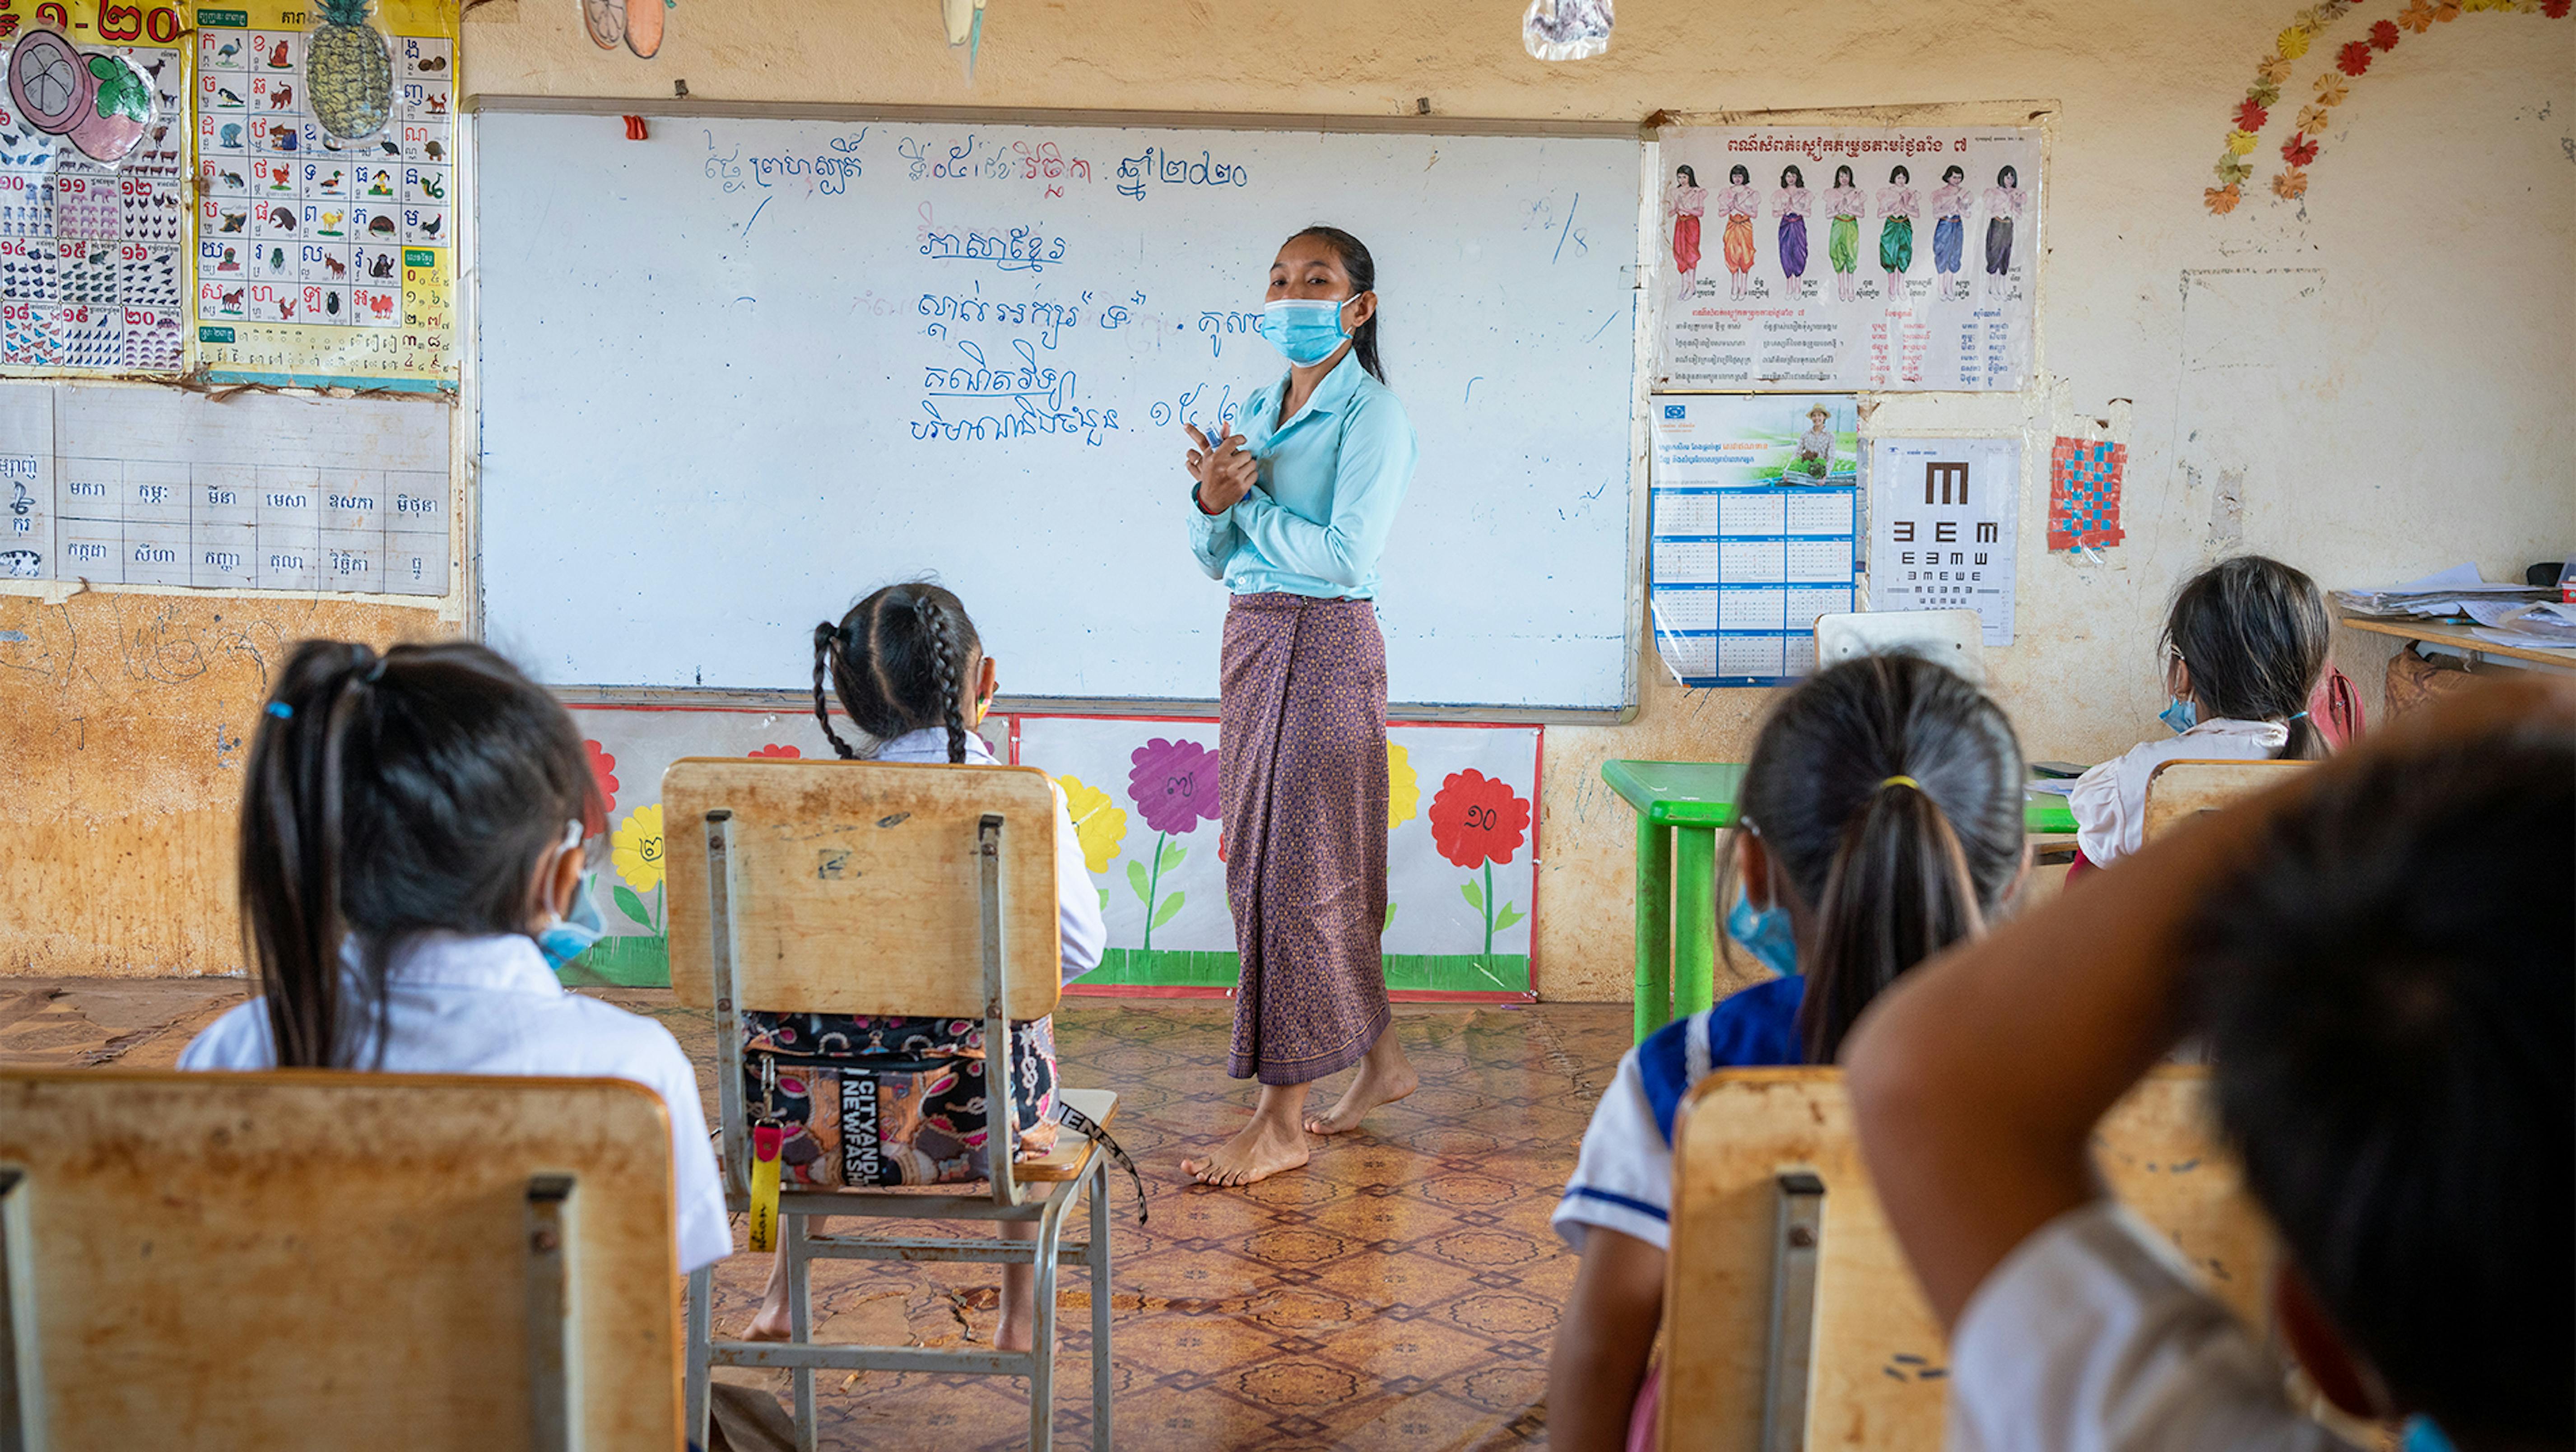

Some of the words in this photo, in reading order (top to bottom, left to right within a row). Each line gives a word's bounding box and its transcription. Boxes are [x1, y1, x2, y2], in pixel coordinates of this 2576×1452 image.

[254, 35, 265, 51] ខ
[1953, 137, 1967, 152] ៧
[1464, 805, 1497, 831] ១០
